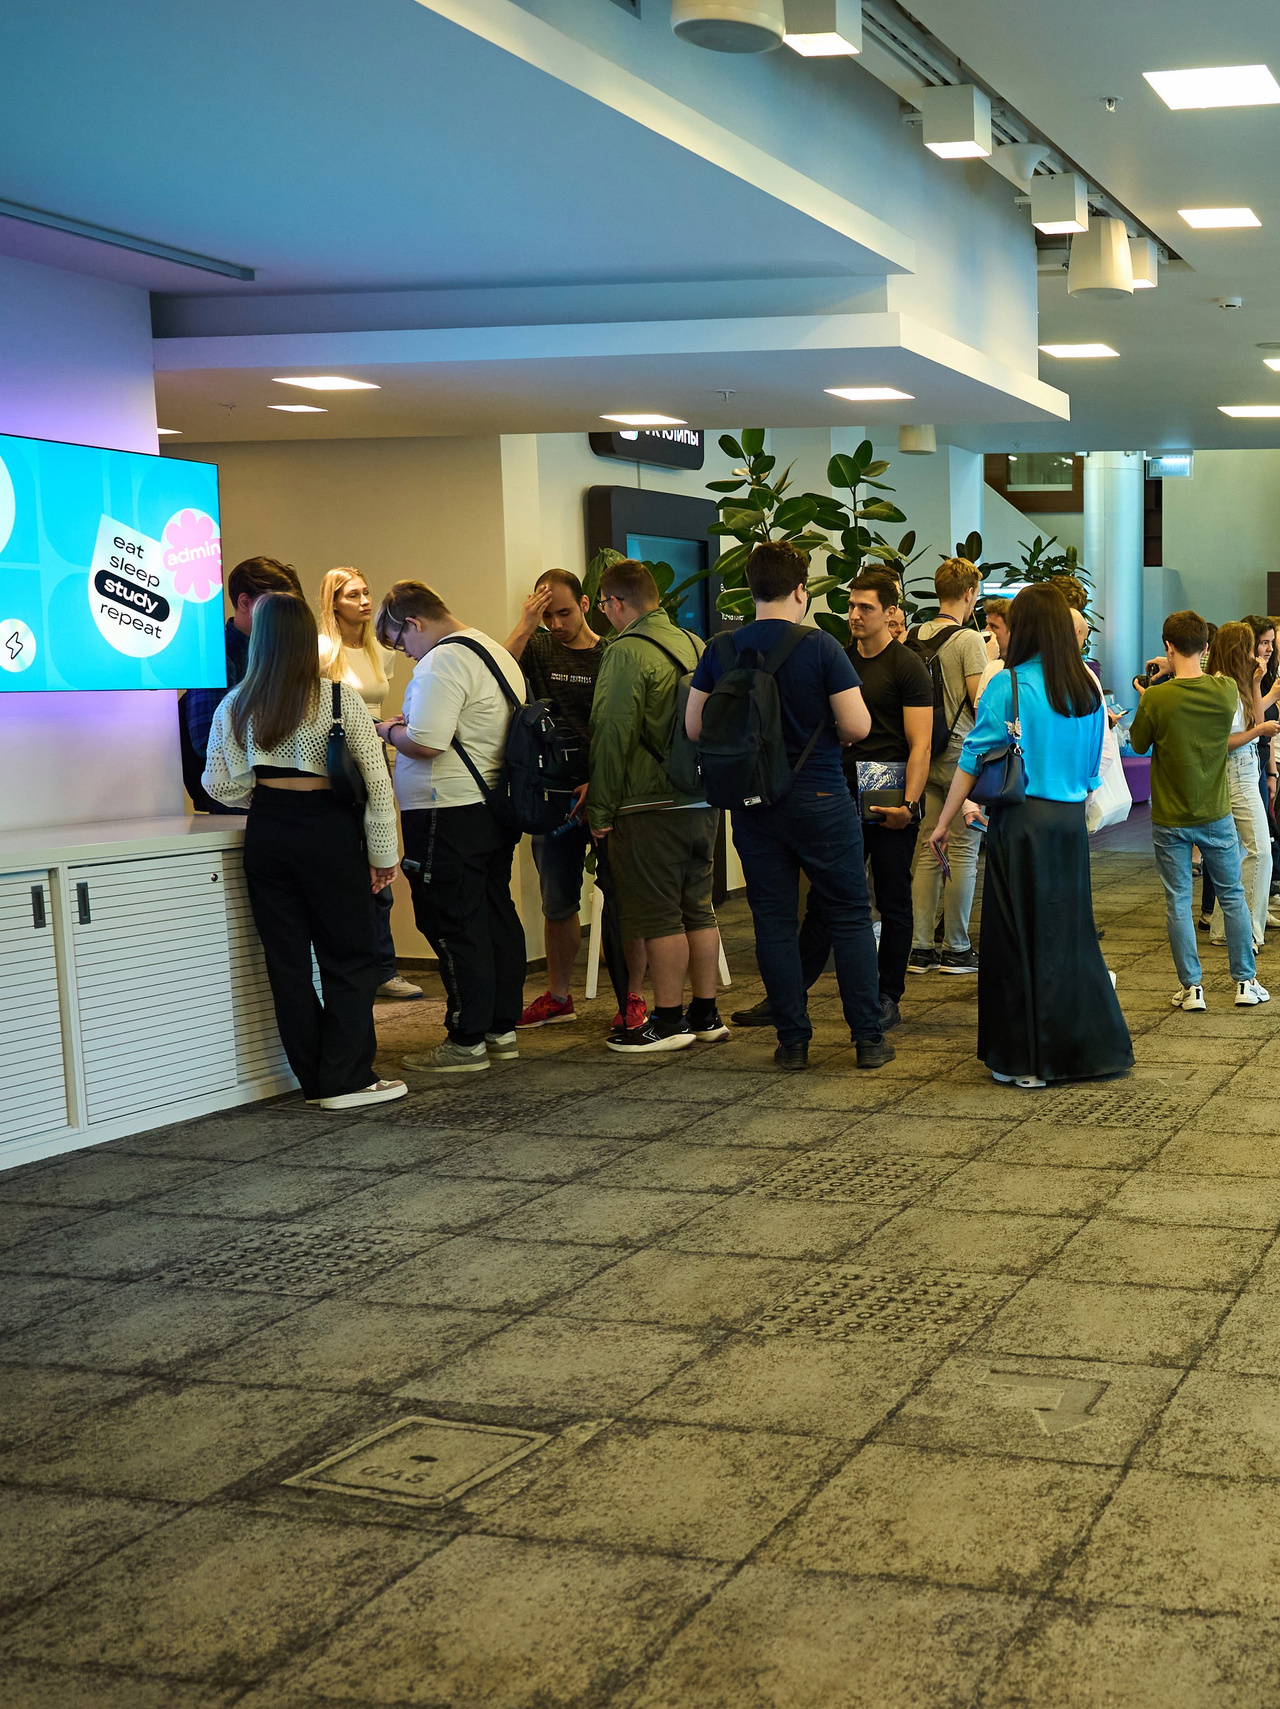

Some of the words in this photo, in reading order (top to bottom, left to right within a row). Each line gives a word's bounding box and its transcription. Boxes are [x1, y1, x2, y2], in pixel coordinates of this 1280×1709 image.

[113, 536, 144, 559] eat
[109, 555, 160, 587] sleep
[104, 578, 159, 614] study
[100, 603, 162, 639] repeat
[359, 1465, 431, 1484] GAS
